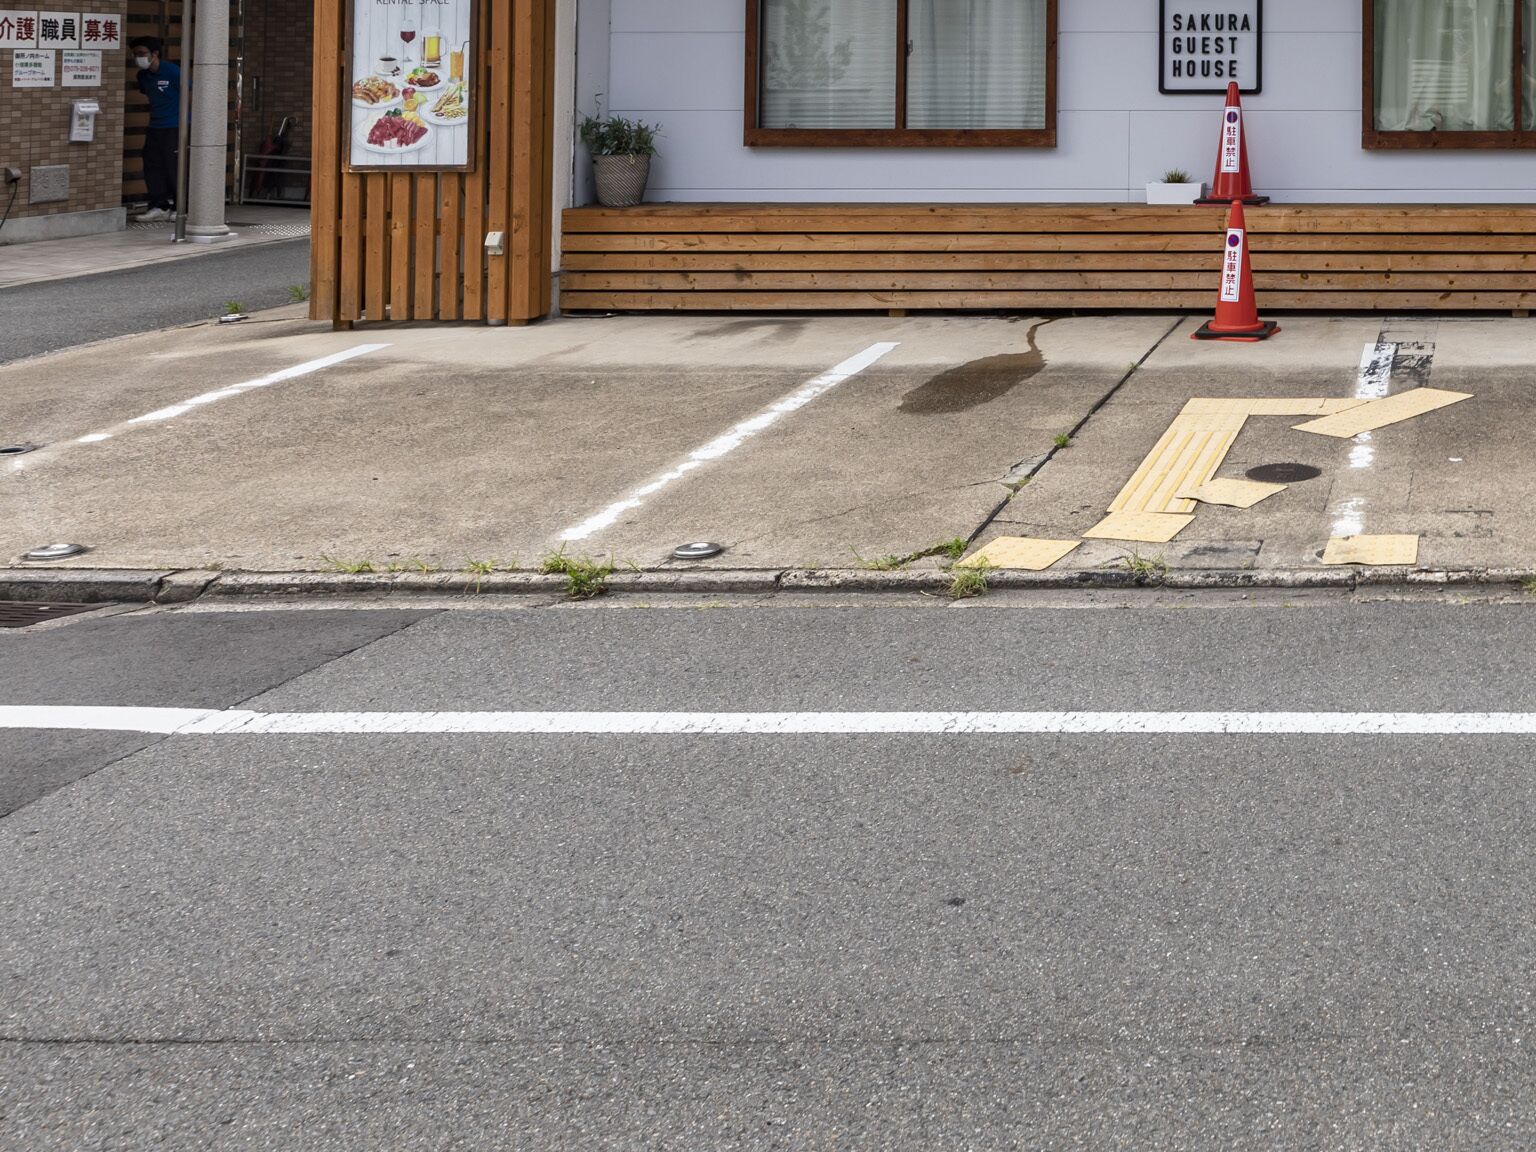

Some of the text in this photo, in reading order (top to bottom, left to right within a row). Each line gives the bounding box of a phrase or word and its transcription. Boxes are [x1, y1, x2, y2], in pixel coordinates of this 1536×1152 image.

[1172, 13, 1251, 31] SAKURA
[1172, 36, 1238, 55] GUEST
[1172, 59, 1238, 78] HOUSE
[1225, 125, 1236, 168] 駐車禁止
[1224, 249, 1238, 297] 駐車禁止
